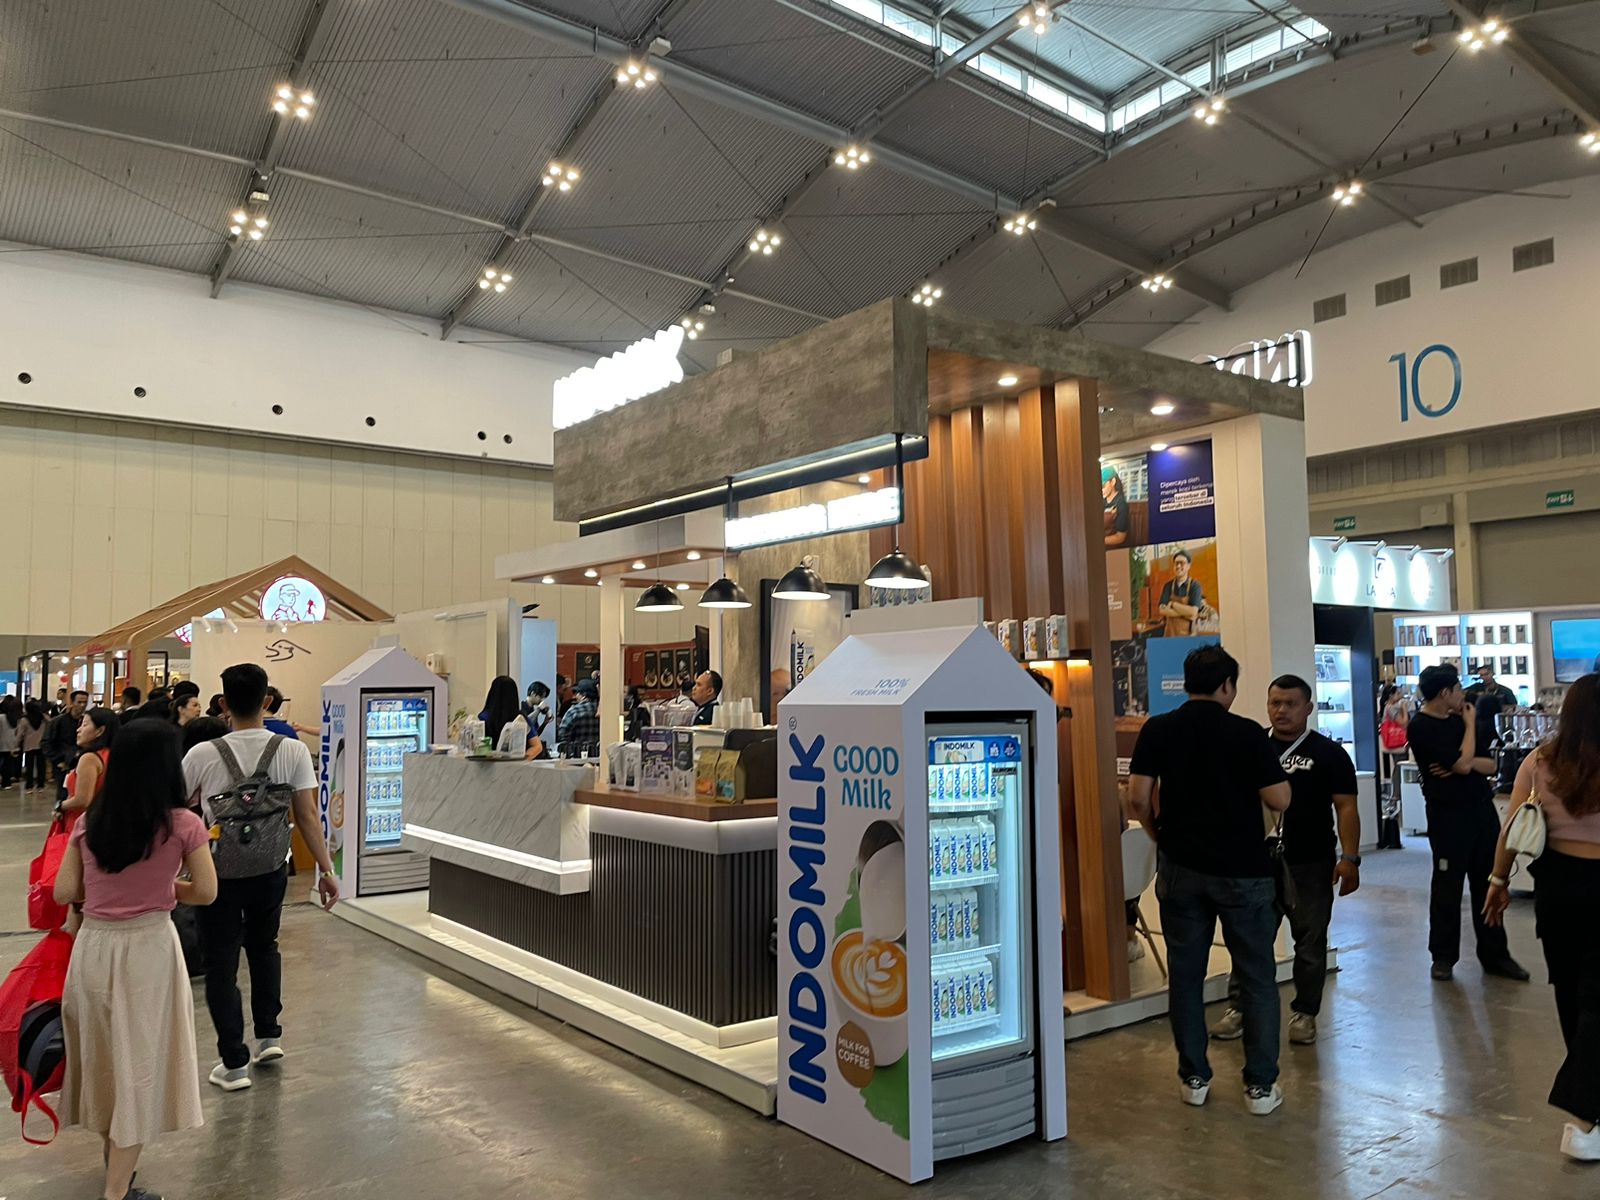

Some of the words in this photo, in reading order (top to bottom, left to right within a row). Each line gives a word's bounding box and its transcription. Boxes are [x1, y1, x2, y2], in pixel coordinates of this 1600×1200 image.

[1388, 344, 1462, 422] 10
[944, 742, 975, 751] INDOMILK
[841, 778, 892, 811] Milk
[788, 733, 826, 1104] INDOMILK
[838, 1036, 855, 1052] MILK
[854, 1042, 870, 1057] FOR
[838, 1048, 870, 1070] COFFEE
